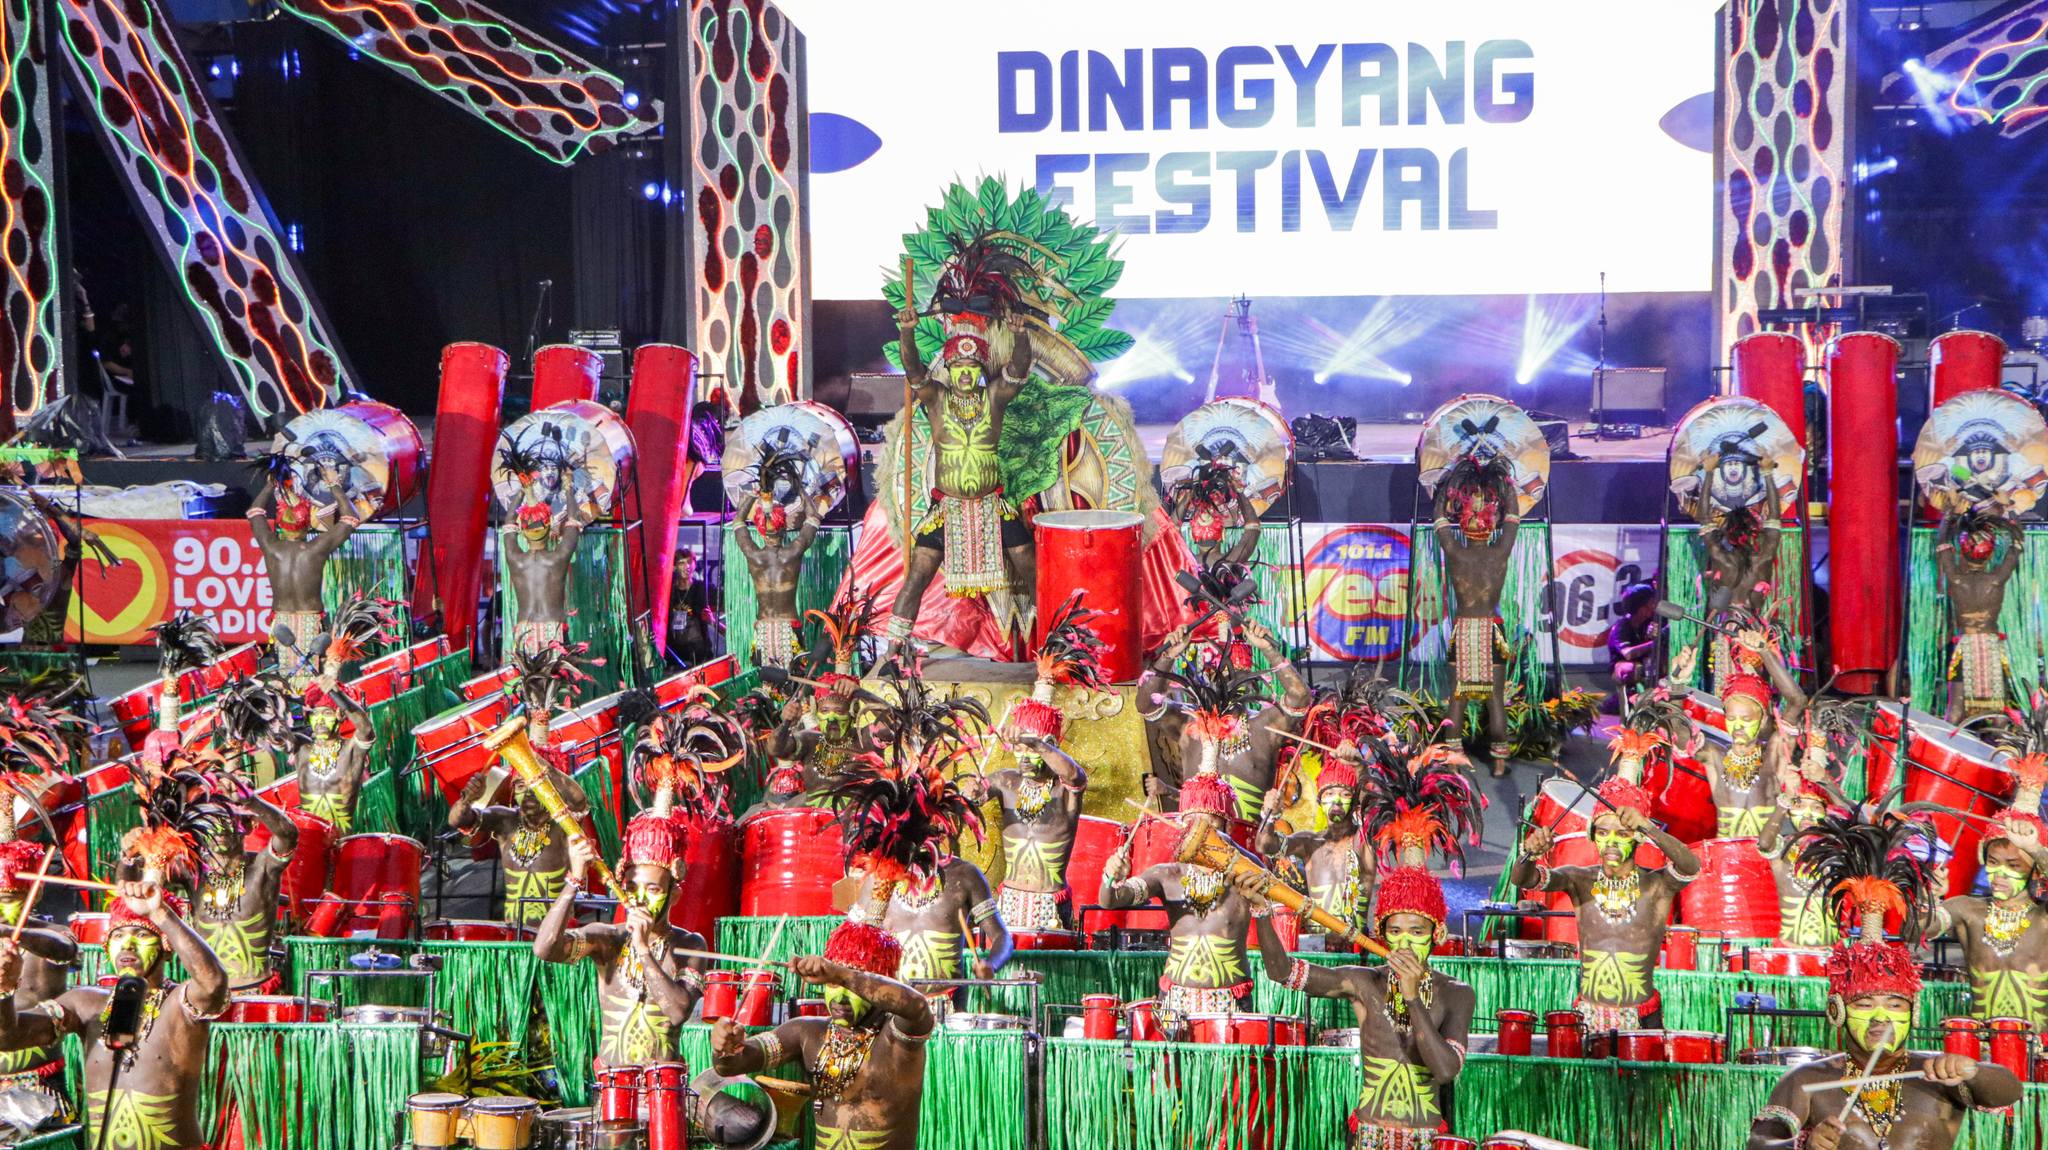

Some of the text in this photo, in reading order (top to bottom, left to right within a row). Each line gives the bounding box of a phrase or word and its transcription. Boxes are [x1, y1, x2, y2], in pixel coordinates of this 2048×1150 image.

[997, 39, 1534, 133] DINAGYANG
[1035, 146, 1498, 235] FESTIVAL
[1336, 543, 1392, 560] 101.1
[173, 576, 273, 608] LOVE
[1345, 626, 1390, 646] FM
